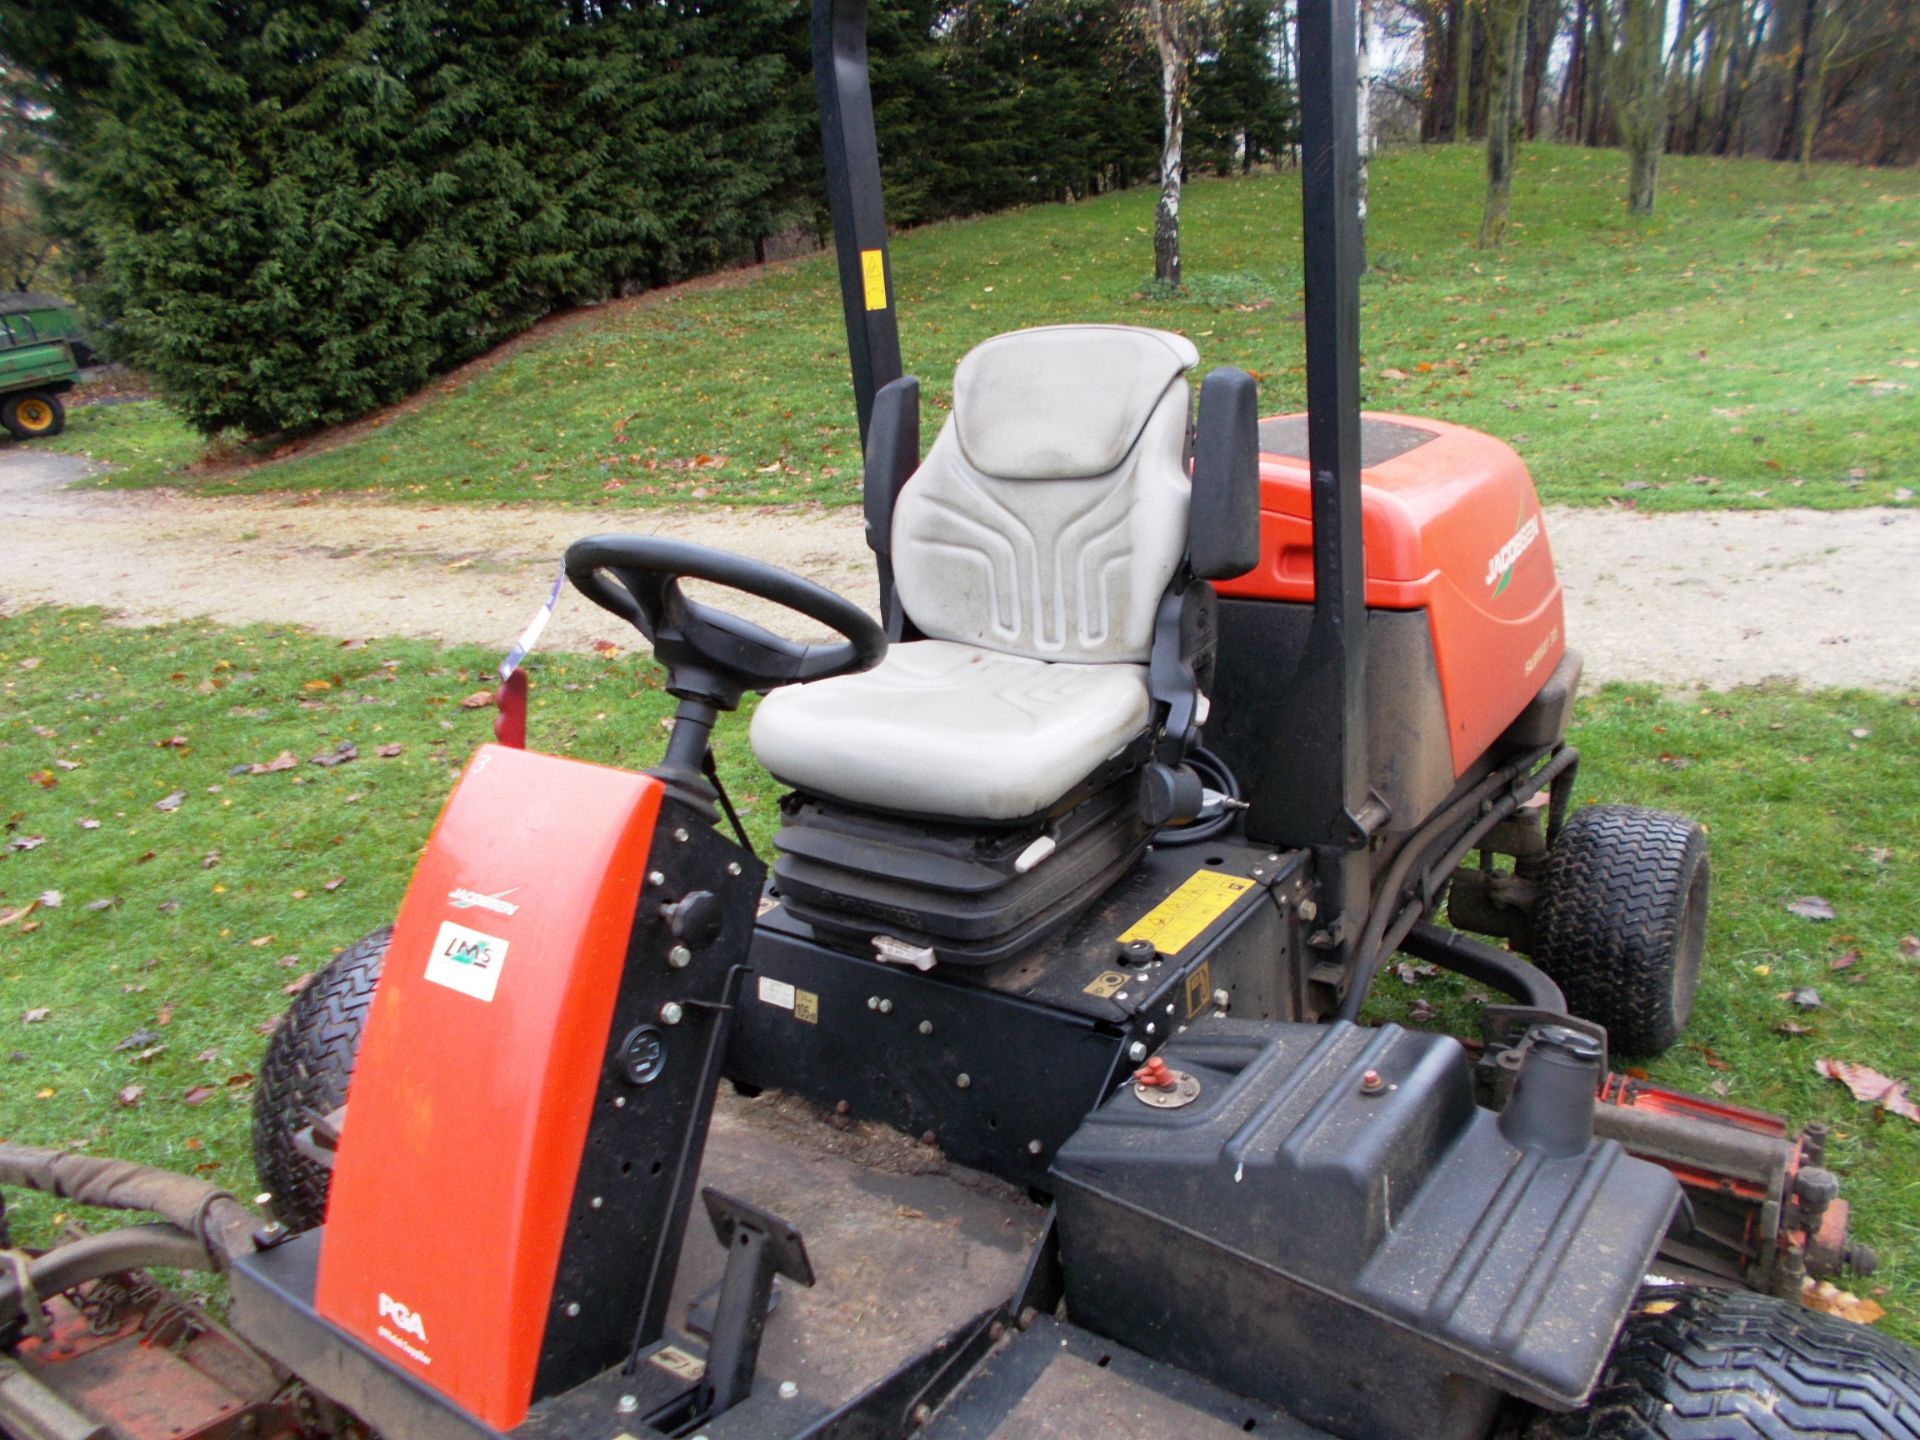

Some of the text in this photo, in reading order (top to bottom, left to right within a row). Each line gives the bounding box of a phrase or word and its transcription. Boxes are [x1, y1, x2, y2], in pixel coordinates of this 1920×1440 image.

[1485, 514, 1539, 586] JACOBSEN
[472, 754, 492, 773] 3
[448, 888, 520, 915] JACOBSEN
[444, 938, 492, 963] LMS
[378, 1292, 426, 1341] PGA
